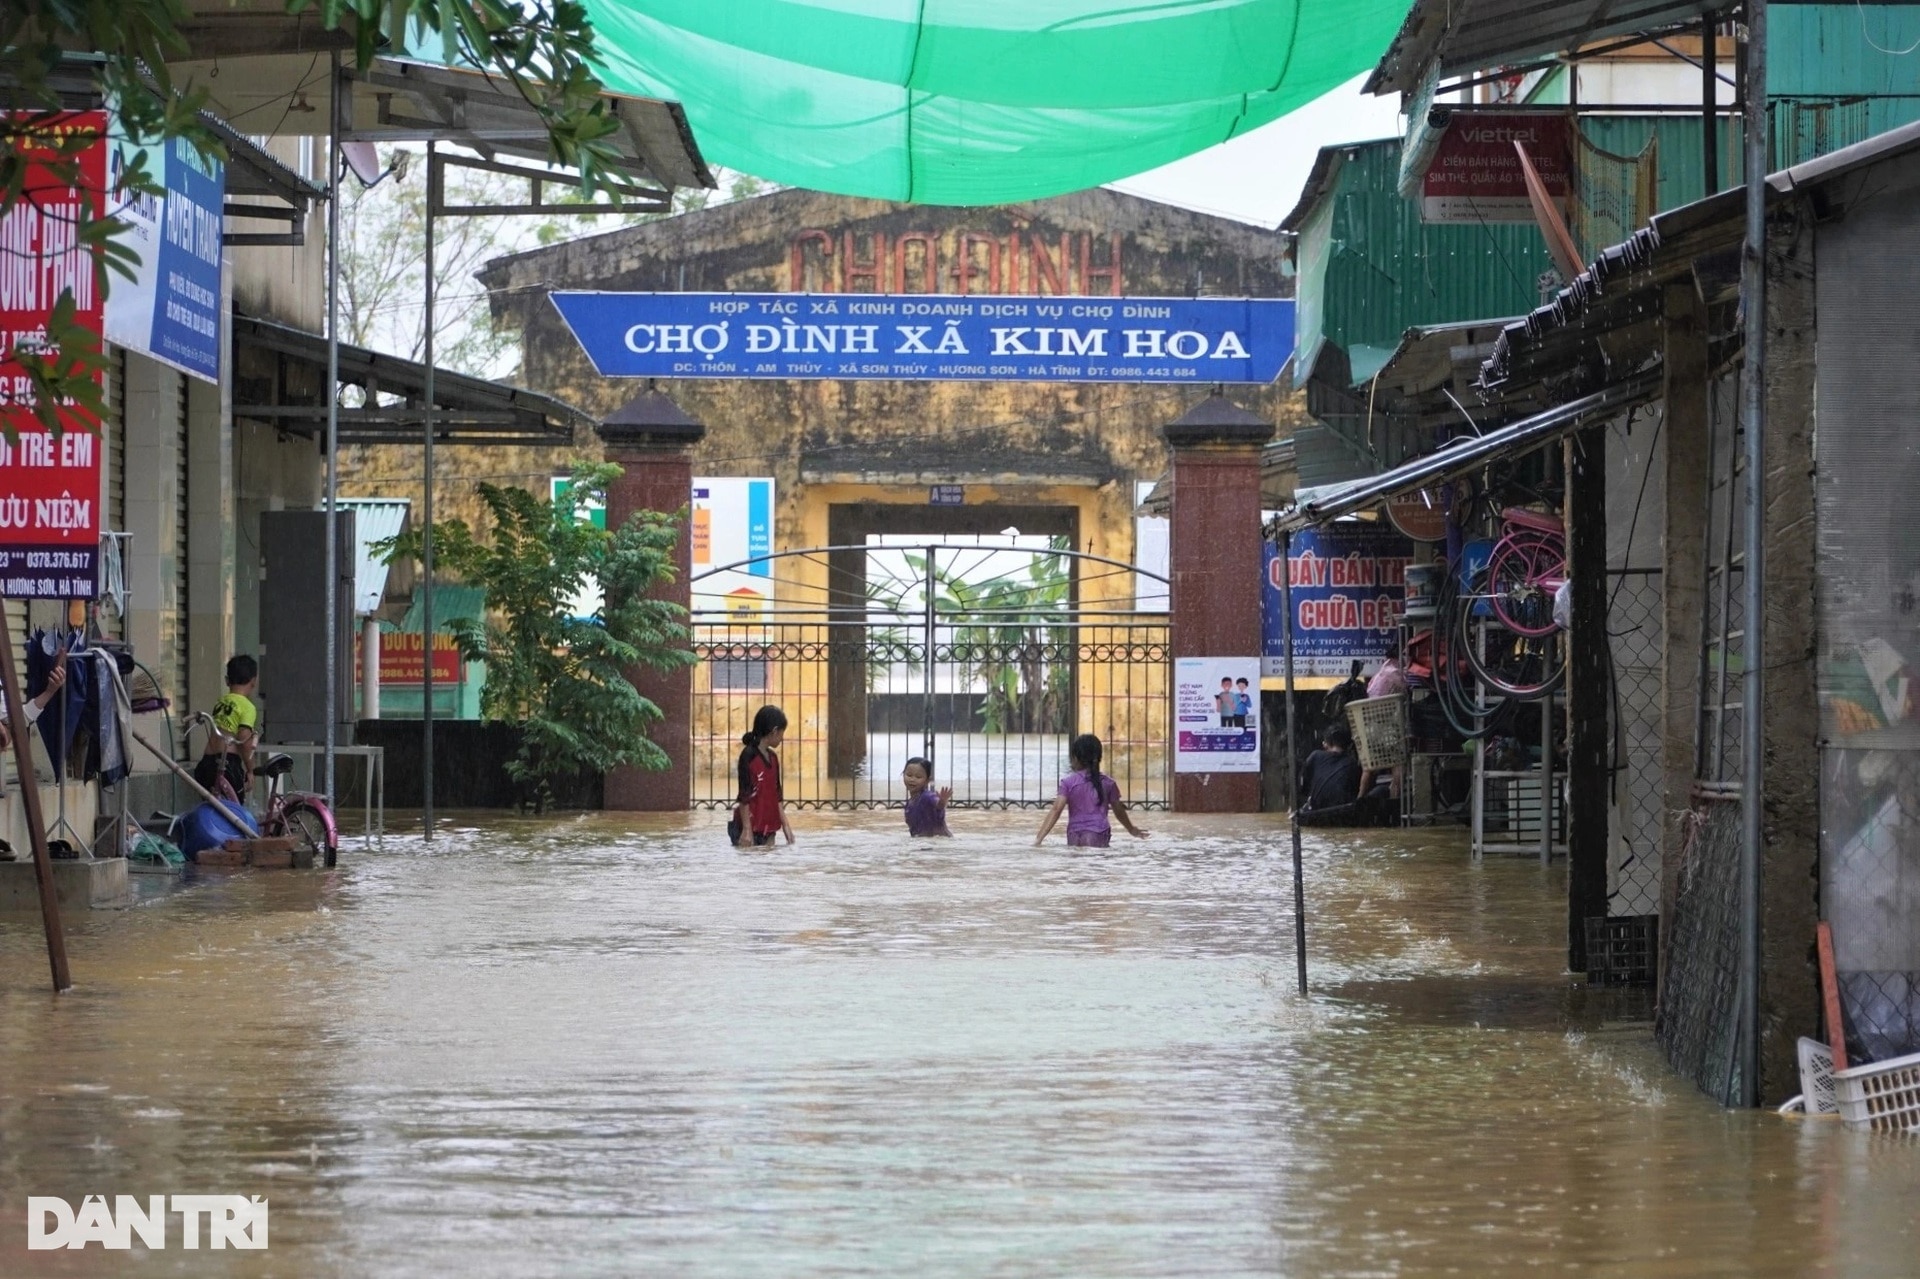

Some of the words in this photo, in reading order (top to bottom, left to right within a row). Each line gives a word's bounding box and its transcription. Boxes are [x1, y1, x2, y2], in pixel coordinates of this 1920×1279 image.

[1460, 128, 1538, 142] viettel
[710, 302, 750, 316] HỢP
[758, 302, 798, 314] TÁC
[810, 300, 839, 315] XÃ
[848, 303, 895, 315] KINH
[902, 304, 973, 316] DOANH
[980, 305, 1028, 319] DỊCH
[1036, 306, 1064, 320] VỤ
[1072, 306, 1114, 320] CHỢ
[1122, 304, 1170, 318] ĐÌNH
[624, 320, 729, 360] CHỢ
[746, 317, 880, 354] ĐÌNH
[894, 319, 970, 354] XÃ
[990, 327, 1108, 357] KIM
[1123, 330, 1251, 360] HOA
[701, 362, 736, 372] THÔN
[756, 364, 776, 373] AM
[787, 362, 822, 373] THỦY
[839, 362, 858, 374] XÃ
[862, 364, 889, 374] SƠN
[892, 362, 928, 374] THỦY
[990, 365, 1017, 375] SƠN
[1028, 366, 1047, 376] HÀ
[1050, 364, 1080, 376] TĨNH
[61, 432, 92, 467] EM
[932, 487, 940, 501] A
[35, 490, 90, 537] NIỆM
[26, 552, 90, 568] 0378.376.617
[1270, 550, 1327, 590] QUẦY
[1330, 550, 1376, 587] BÁN
[7, 578, 35, 596] HƯƠNG
[38, 578, 58, 597] SƠN,
[59, 576, 70, 596] HÀ
[72, 576, 92, 596] TĨNH
[1299, 594, 1360, 630] CHỮA
